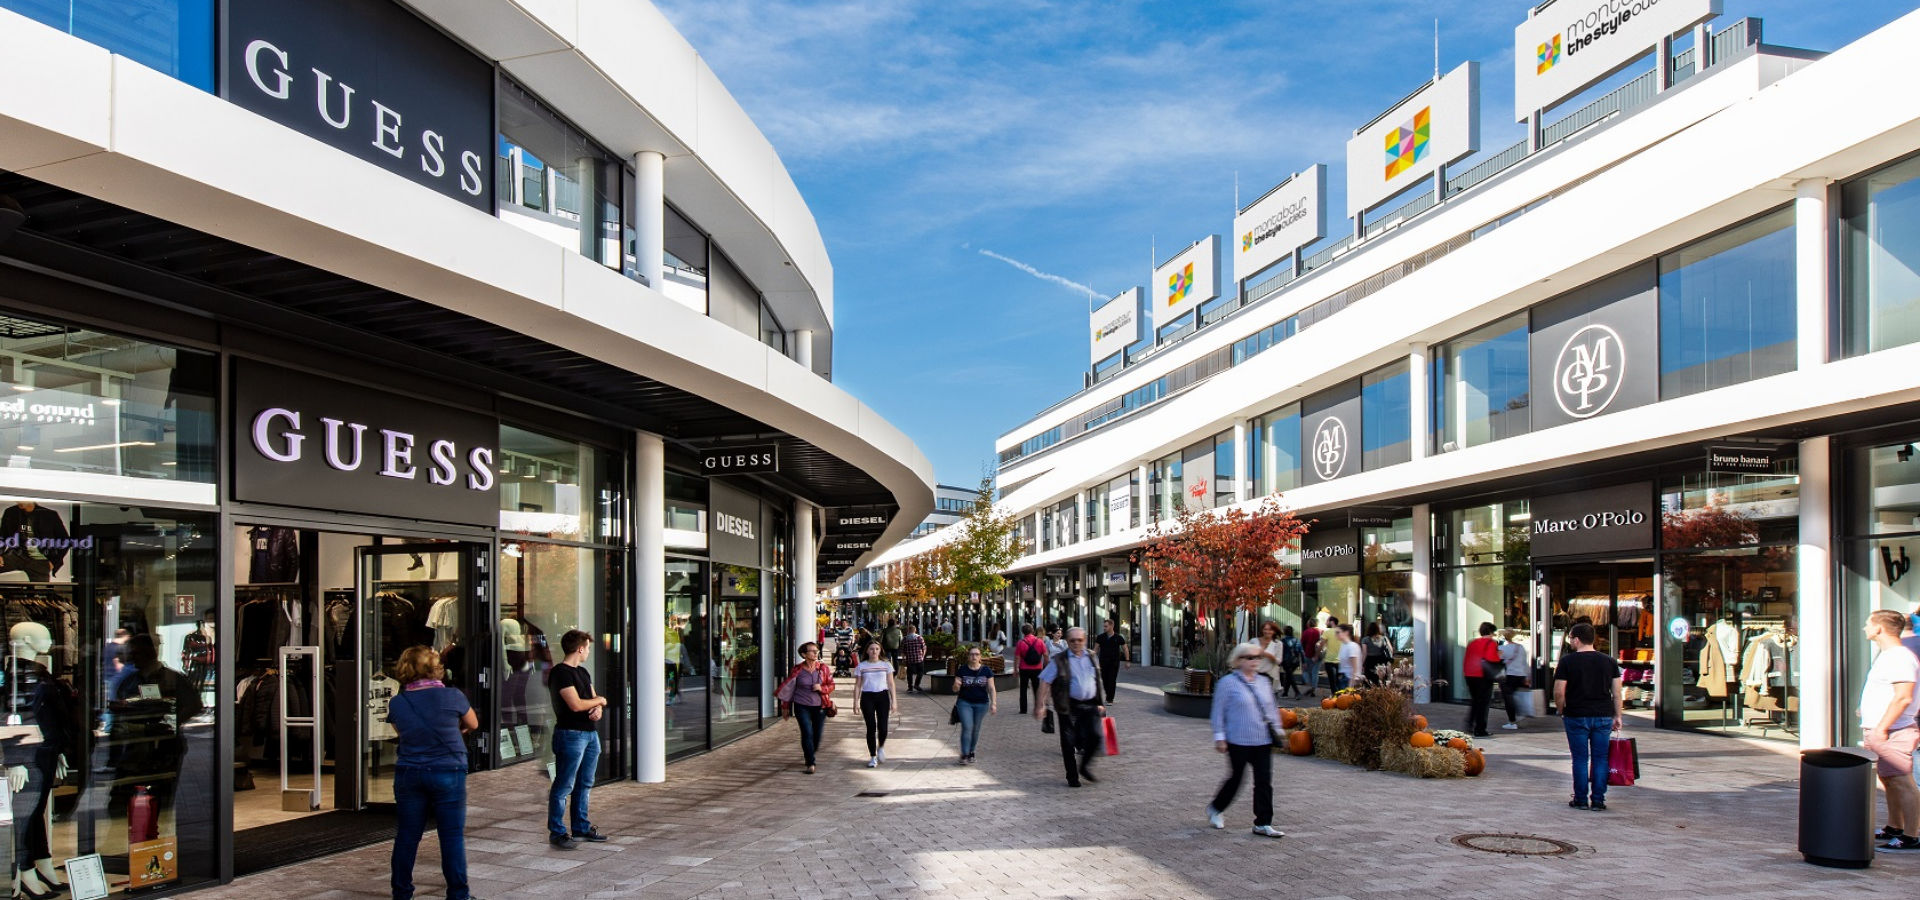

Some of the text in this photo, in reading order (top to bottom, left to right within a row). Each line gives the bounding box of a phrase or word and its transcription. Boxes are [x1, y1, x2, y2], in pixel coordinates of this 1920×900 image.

[245, 39, 483, 196] GUESS
[1254, 196, 1307, 235] montabaur
[252, 407, 495, 491] GUESS
[705, 453, 772, 469] GUESS
[1713, 453, 1769, 464] bruno banani
[716, 511, 755, 540] DIESEL
[840, 516, 886, 525] DIESEL
[1534, 509, 1644, 534] Marc O'Polo
[1302, 544, 1354, 560] Marc O'Polo
